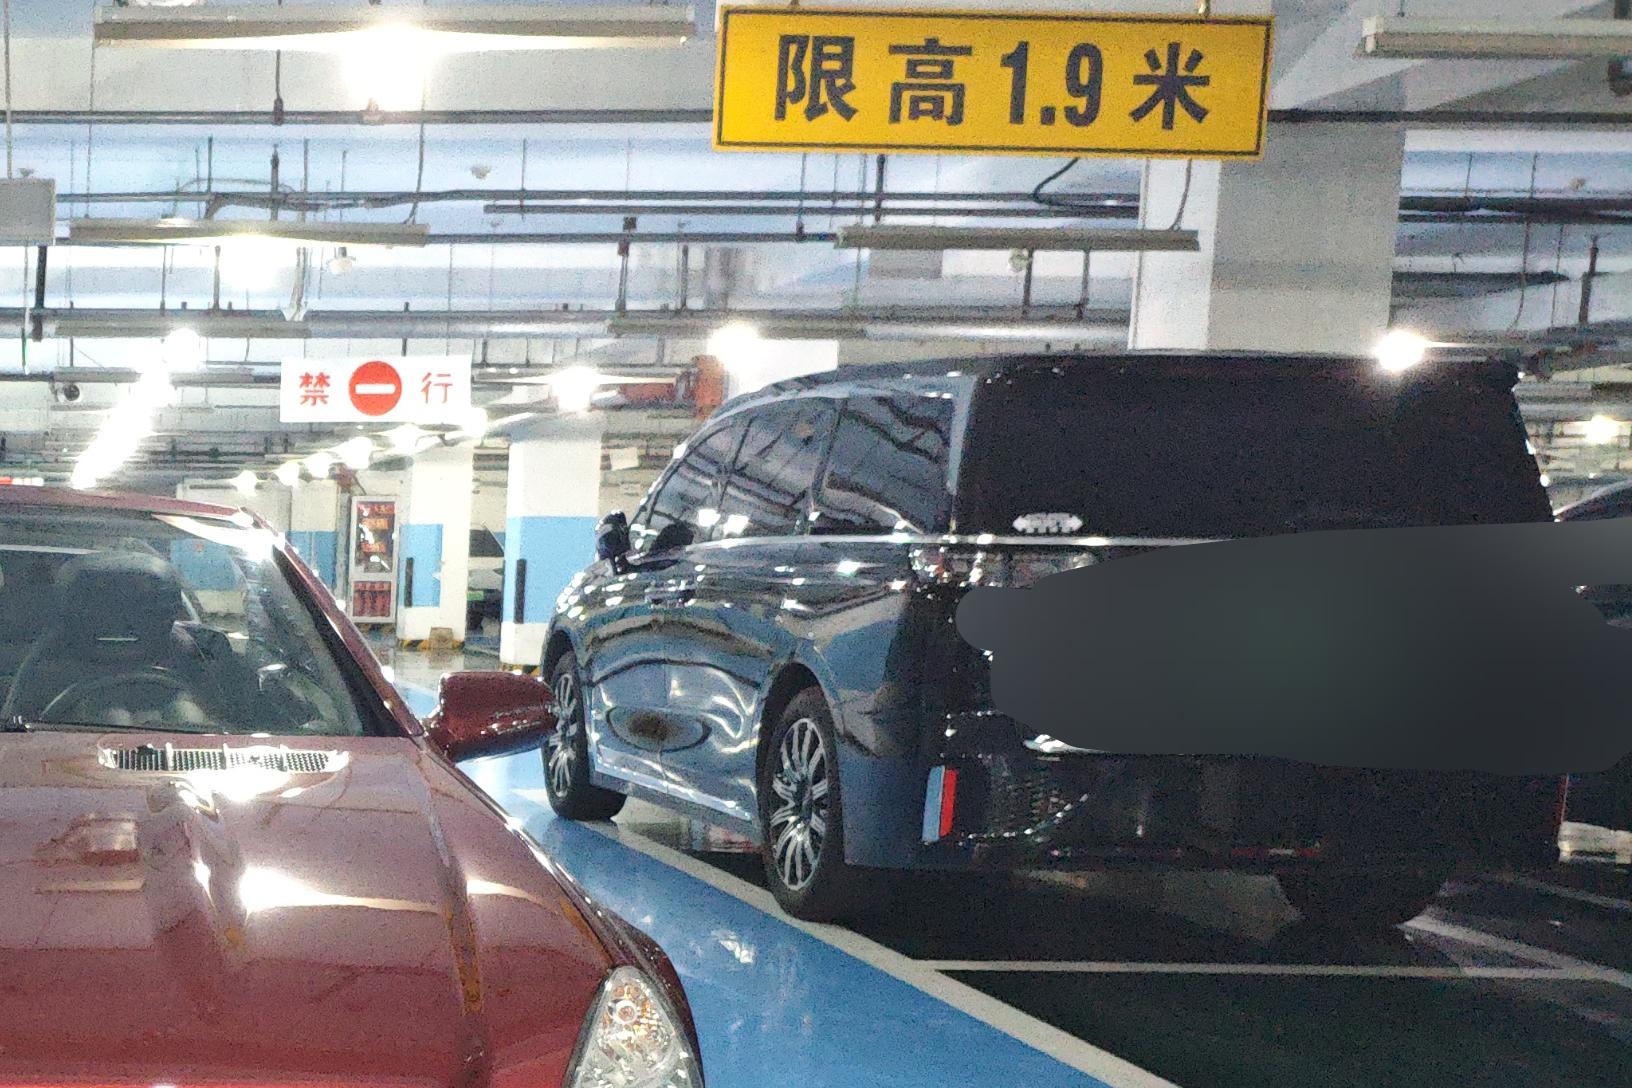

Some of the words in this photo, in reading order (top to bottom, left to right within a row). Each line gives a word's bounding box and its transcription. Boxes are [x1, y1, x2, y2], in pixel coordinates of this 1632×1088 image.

[774, 34, 1210, 131] 限高1.9米
[299, 371, 331, 407] 禁
[421, 371, 453, 404] 行
